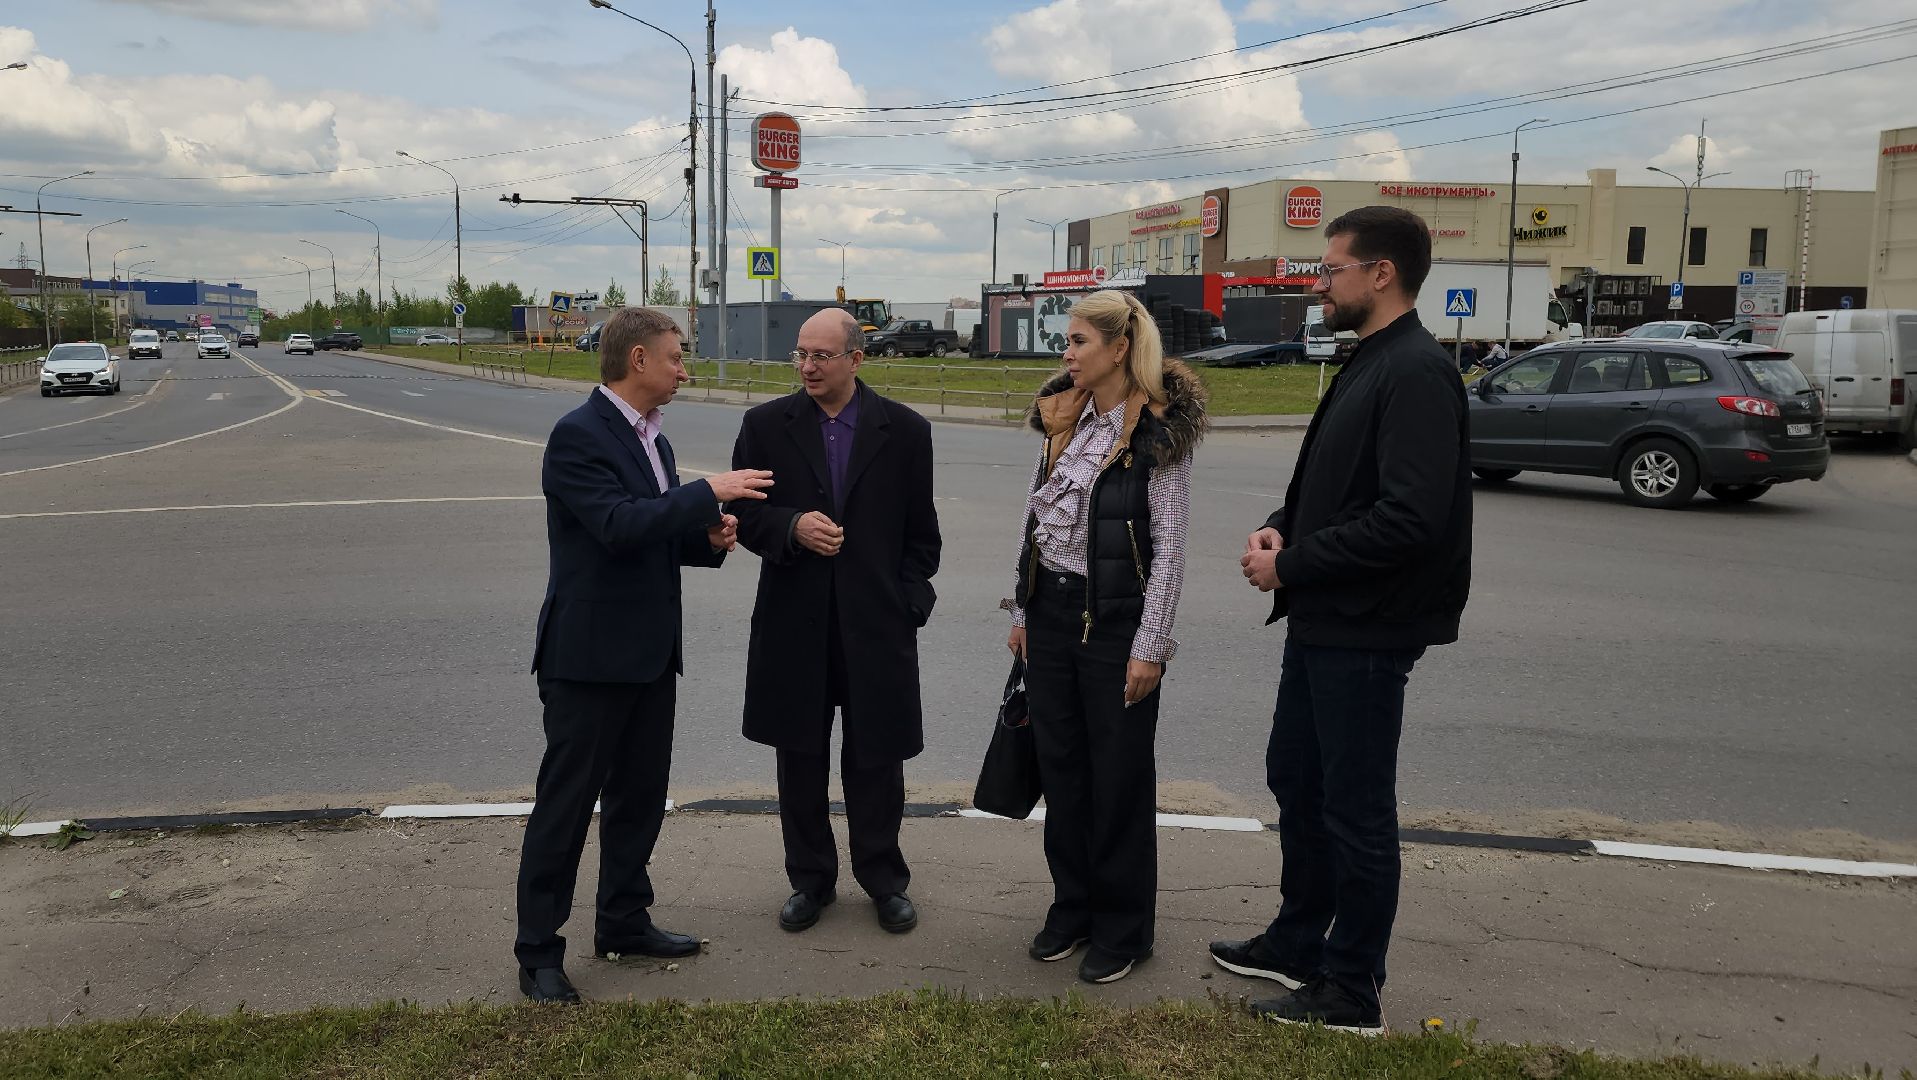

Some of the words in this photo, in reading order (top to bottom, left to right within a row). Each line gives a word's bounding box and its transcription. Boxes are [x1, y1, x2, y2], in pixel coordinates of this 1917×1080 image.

[759, 130, 799, 144] BURGER
[759, 141, 799, 160] KING
[1381, 186, 1403, 196] ВСЕ
[1406, 187, 1488, 198] ИНСТРУМЕНТЫ
[1287, 198, 1322, 207] BURGER
[1287, 207, 1321, 218] KING
[1203, 217, 1218, 229] KING
